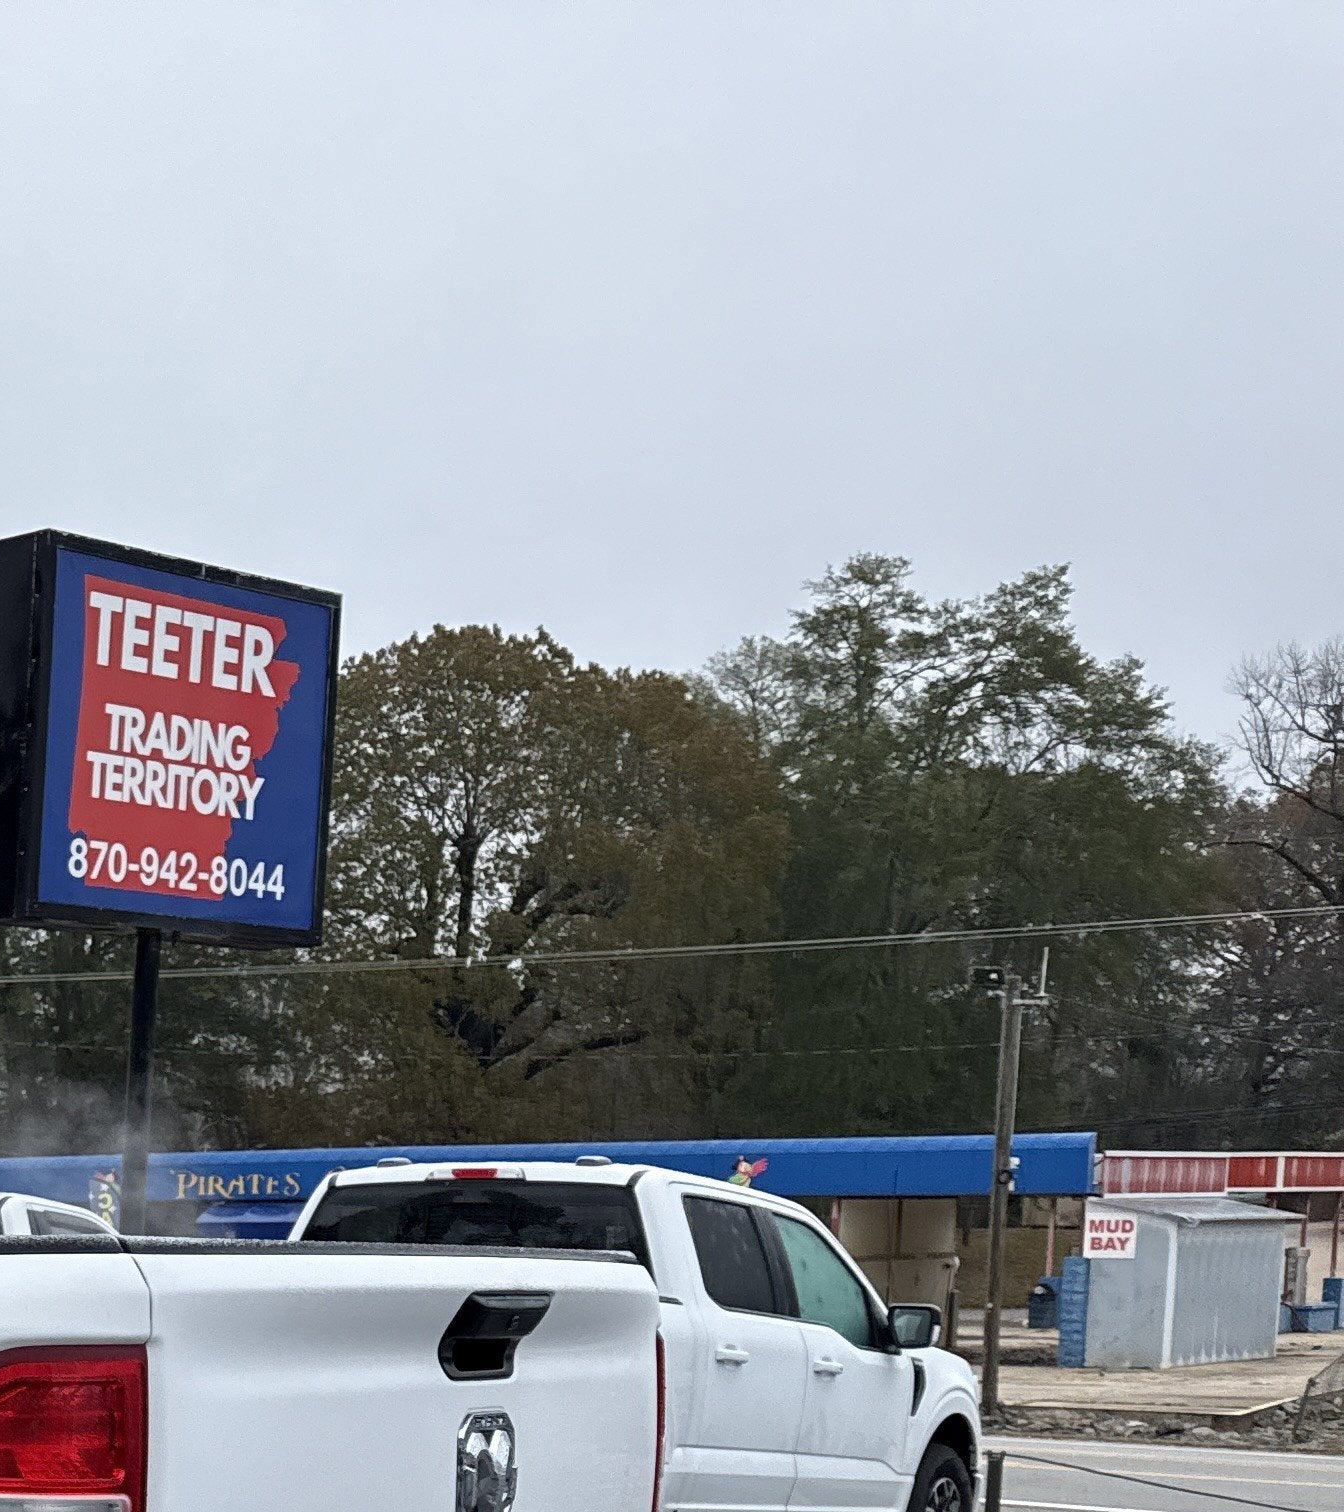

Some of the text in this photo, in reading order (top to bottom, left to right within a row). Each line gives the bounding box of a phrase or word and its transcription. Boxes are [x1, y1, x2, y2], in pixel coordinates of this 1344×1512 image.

[89, 590, 277, 699] TEETER
[105, 702, 252, 772] TRADING
[85, 750, 266, 821] TERRITORY
[67, 837, 286, 902] 870-942-8044
[1089, 1220, 1135, 1233] MUD
[1090, 1237, 1130, 1251] BAY
